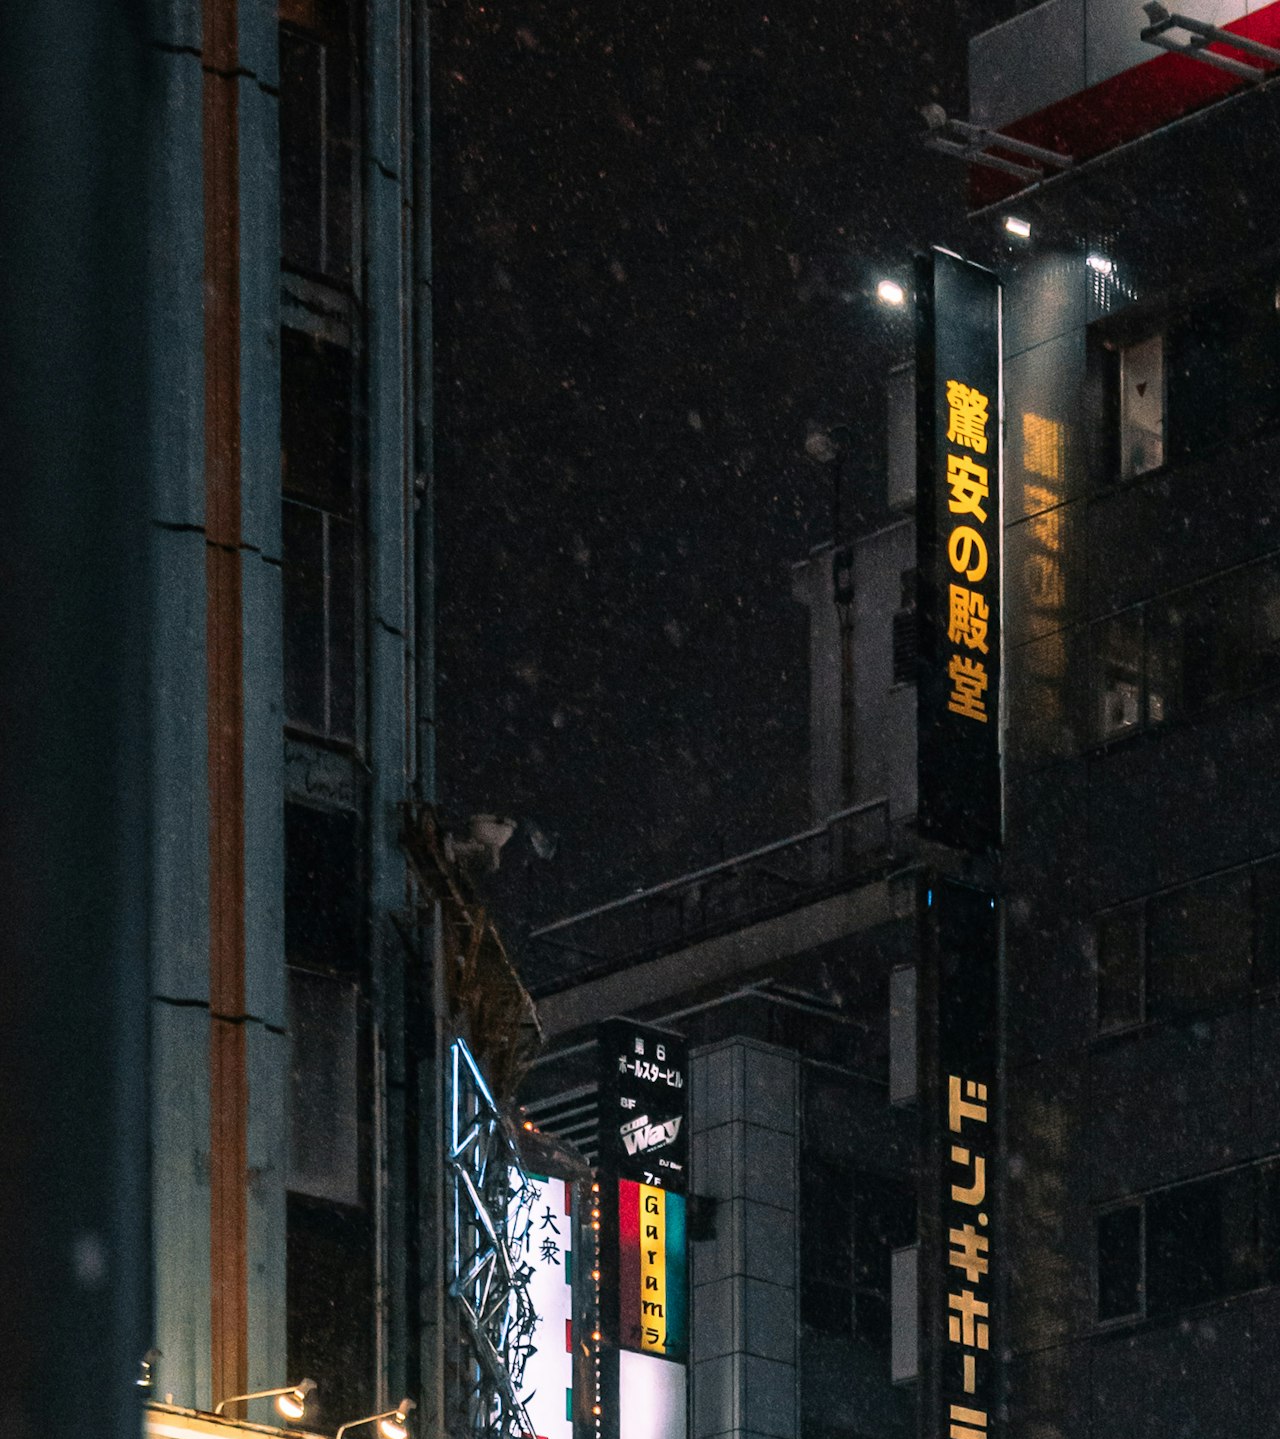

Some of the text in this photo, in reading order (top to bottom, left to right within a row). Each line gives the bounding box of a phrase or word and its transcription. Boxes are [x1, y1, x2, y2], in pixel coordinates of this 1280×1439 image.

[946, 379, 989, 721] 驚安の殿堂
[643, 1172, 661, 1186] 7F
[540, 1206, 561, 1266] 大衆
